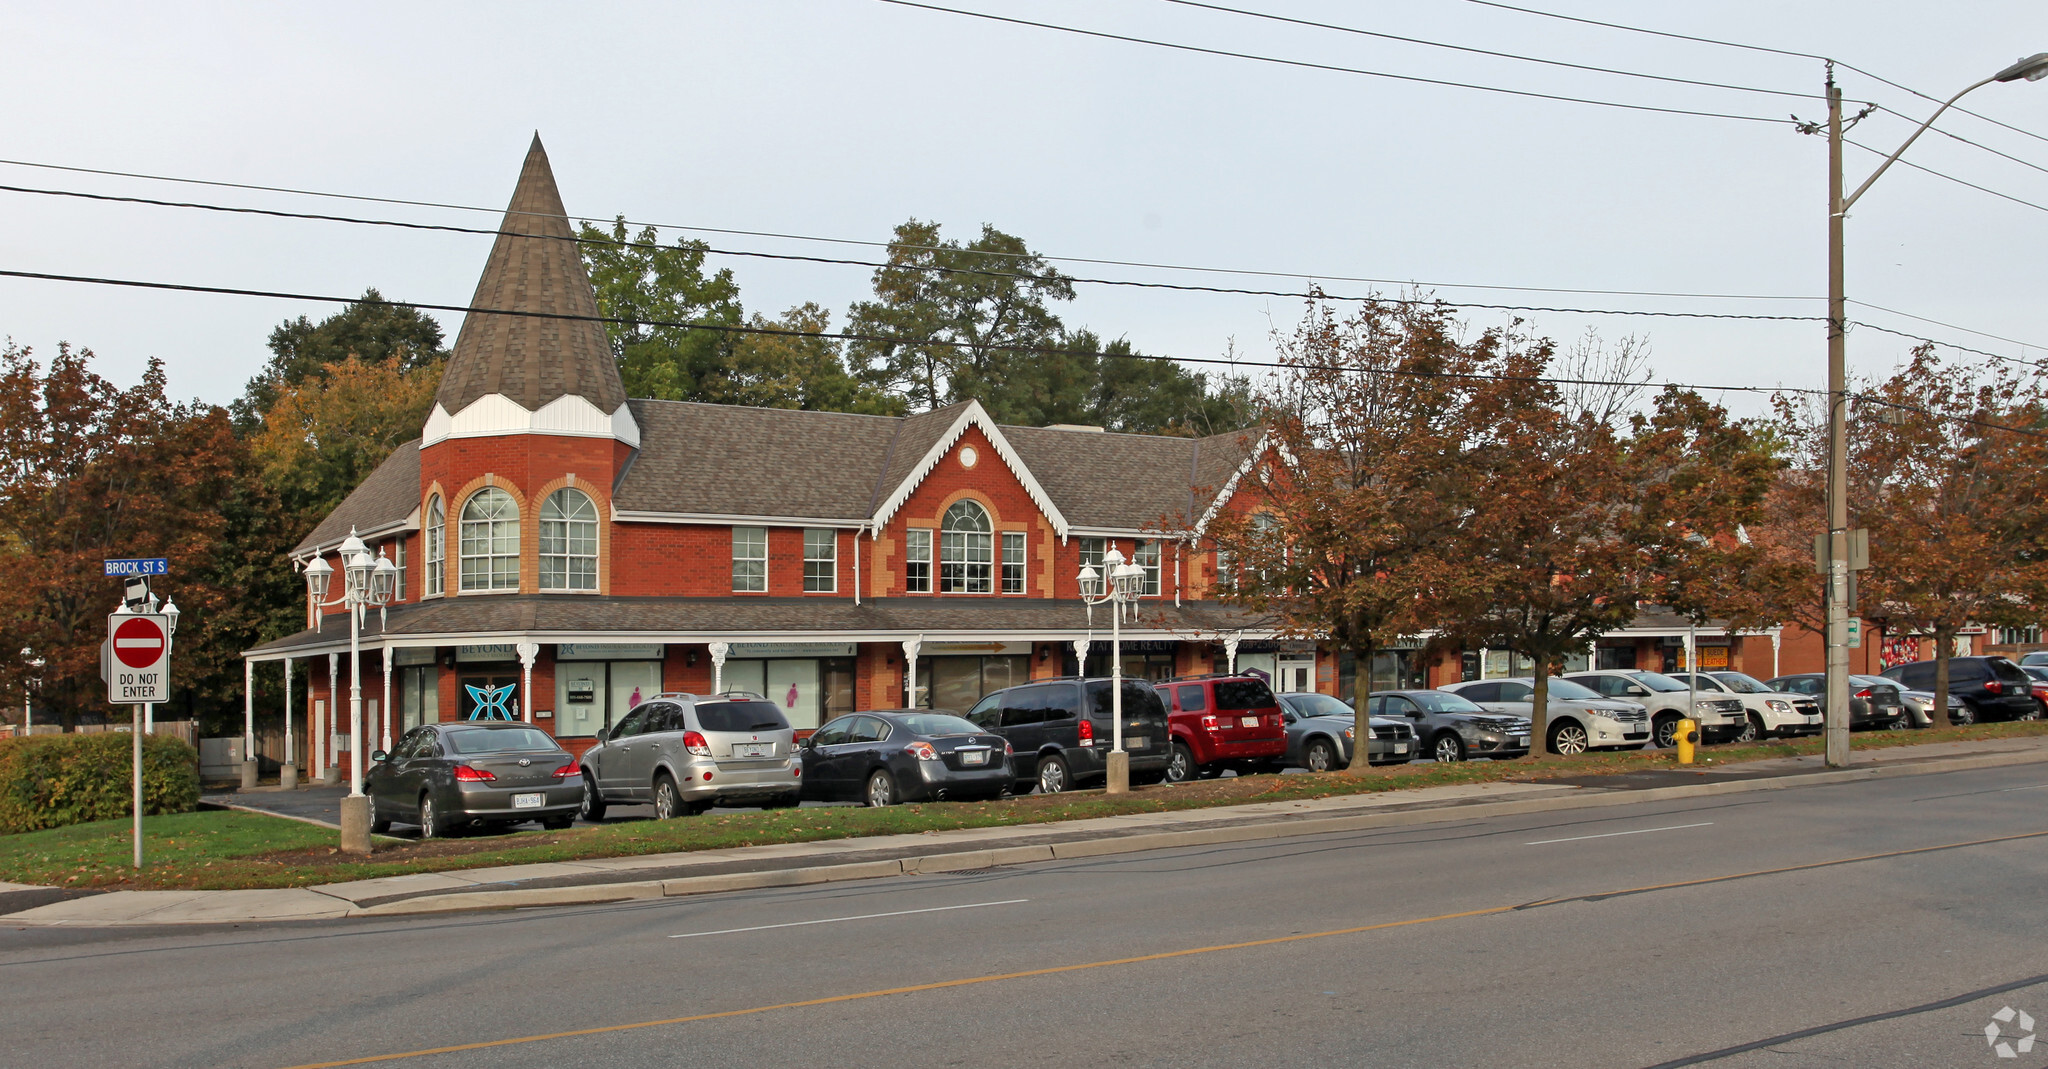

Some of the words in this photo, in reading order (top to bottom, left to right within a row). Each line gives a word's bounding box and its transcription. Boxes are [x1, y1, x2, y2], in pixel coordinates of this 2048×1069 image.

[106, 561, 139, 574] BROCK
[143, 561, 155, 573] ST
[158, 561, 165, 573] S
[462, 644, 513, 654] BEYOND
[1141, 640, 1175, 650] REALTY
[1707, 648, 1724, 656] SUEDE
[1705, 657, 1727, 666] LEATHER
[120, 673, 134, 685] DO
[138, 673, 159, 685] NOT
[123, 686, 156, 698] ENTER
